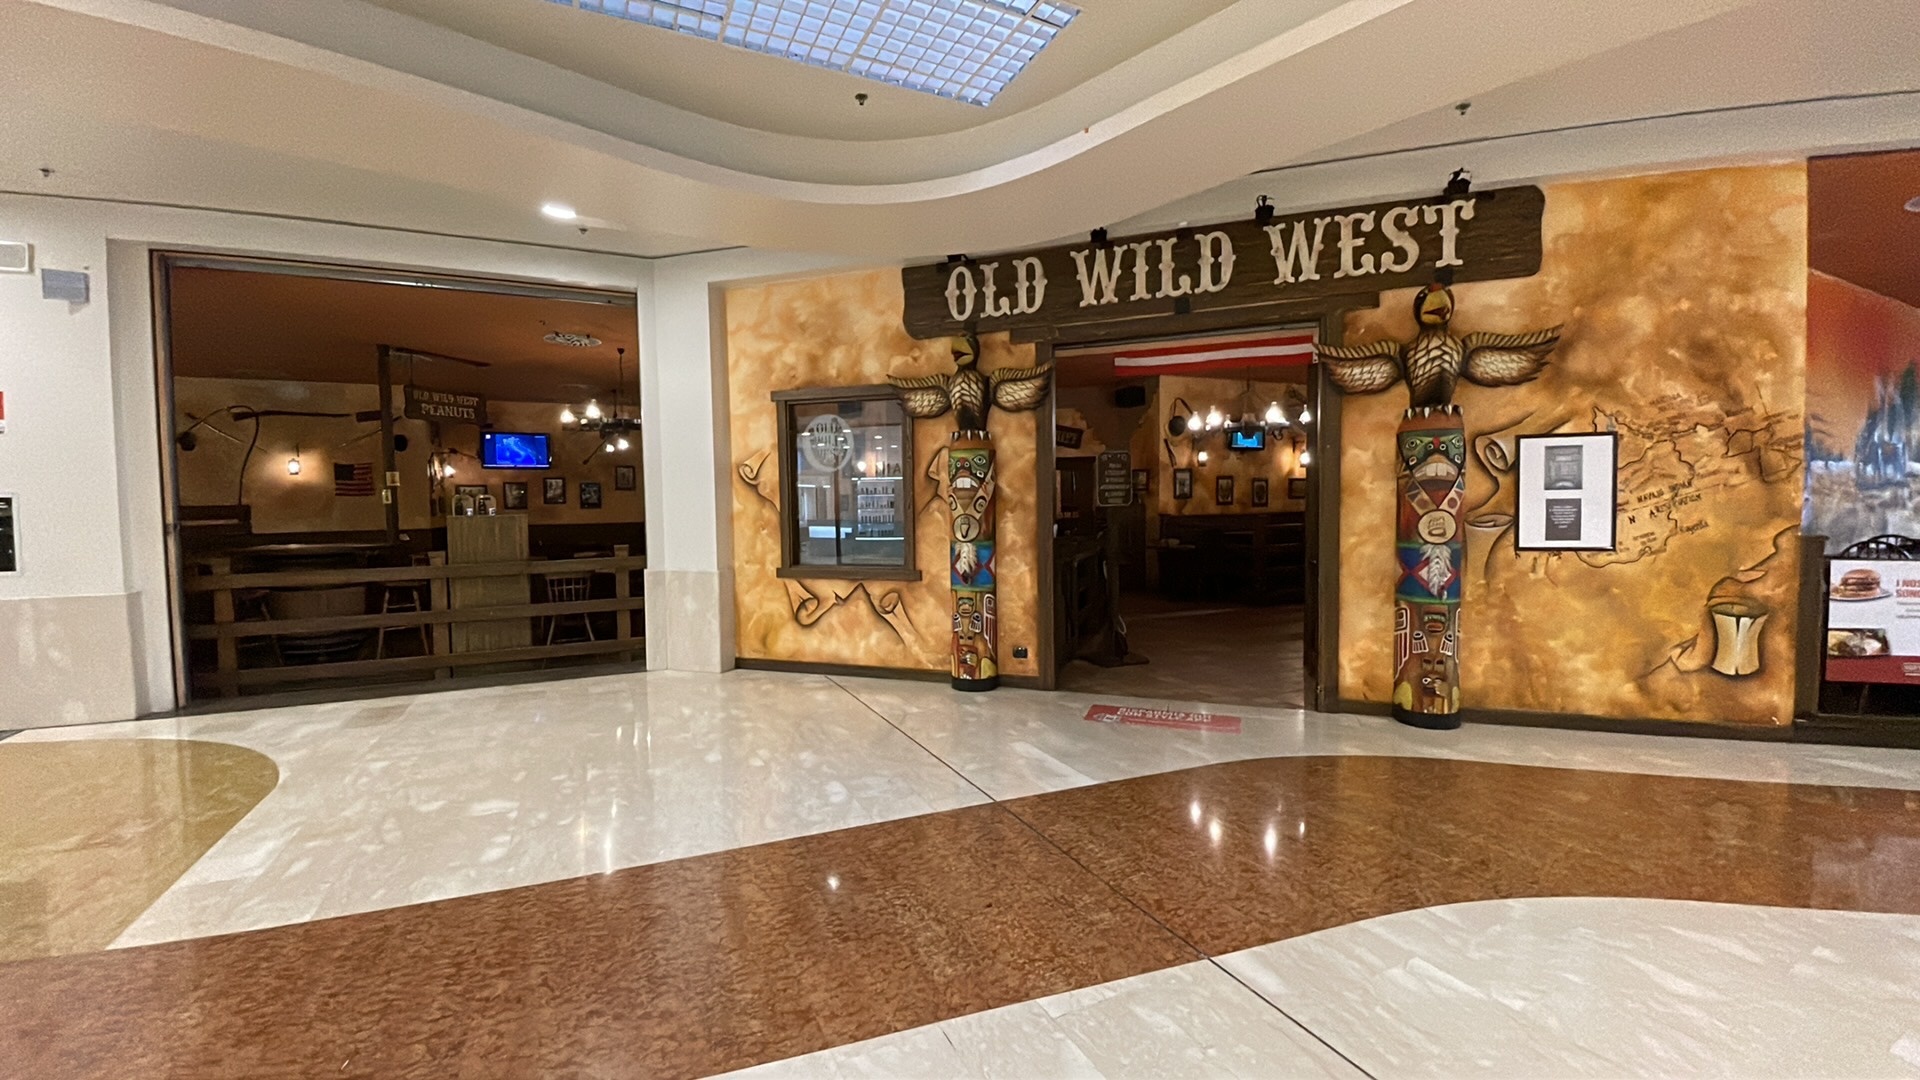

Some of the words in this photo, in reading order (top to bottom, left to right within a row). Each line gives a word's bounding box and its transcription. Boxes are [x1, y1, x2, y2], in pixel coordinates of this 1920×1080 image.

[945, 256, 1048, 322] OLD
[1070, 231, 1236, 308] WILD
[1263, 198, 1476, 285] WEST
[432, 392, 454, 403] WILD
[456, 395, 479, 406] WEST
[421, 403, 475, 419] PEANUTS
